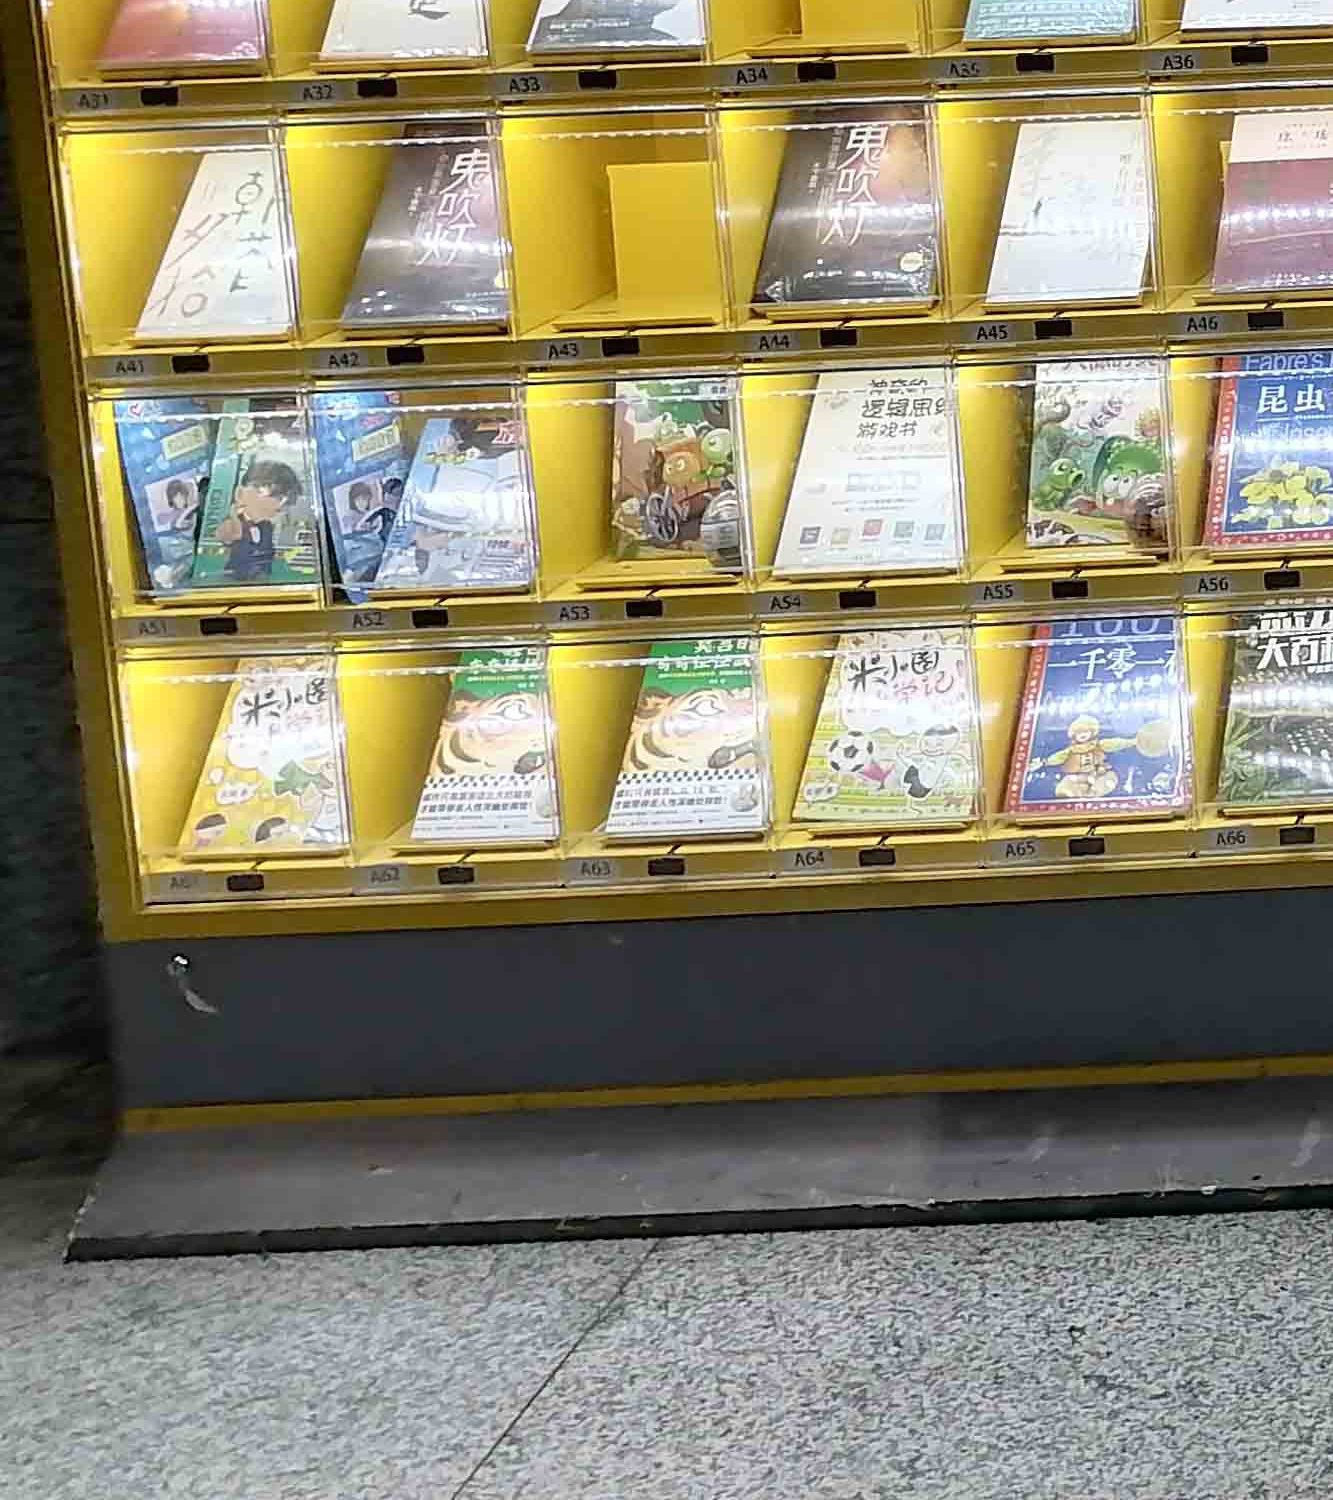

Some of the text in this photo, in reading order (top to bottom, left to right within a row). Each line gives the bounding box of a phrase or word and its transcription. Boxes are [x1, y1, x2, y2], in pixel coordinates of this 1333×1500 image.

[1162, 54, 1195, 71] A36
[508, 76, 541, 92] A33
[735, 68, 768, 85] A34
[821, 125, 889, 247] 鬼吹灯
[416, 147, 492, 267] 鬼吹灯
[1186, 316, 1219, 332] A46
[976, 325, 1009, 341] A45
[327, 351, 360, 368] A42
[983, 584, 1014, 601] A55
[559, 605, 591, 621] A53
[847, 651, 940, 692] 米小圈
[1215, 831, 1247, 847] A66
[1005, 842, 1037, 858] A65
[794, 851, 826, 867] A64
